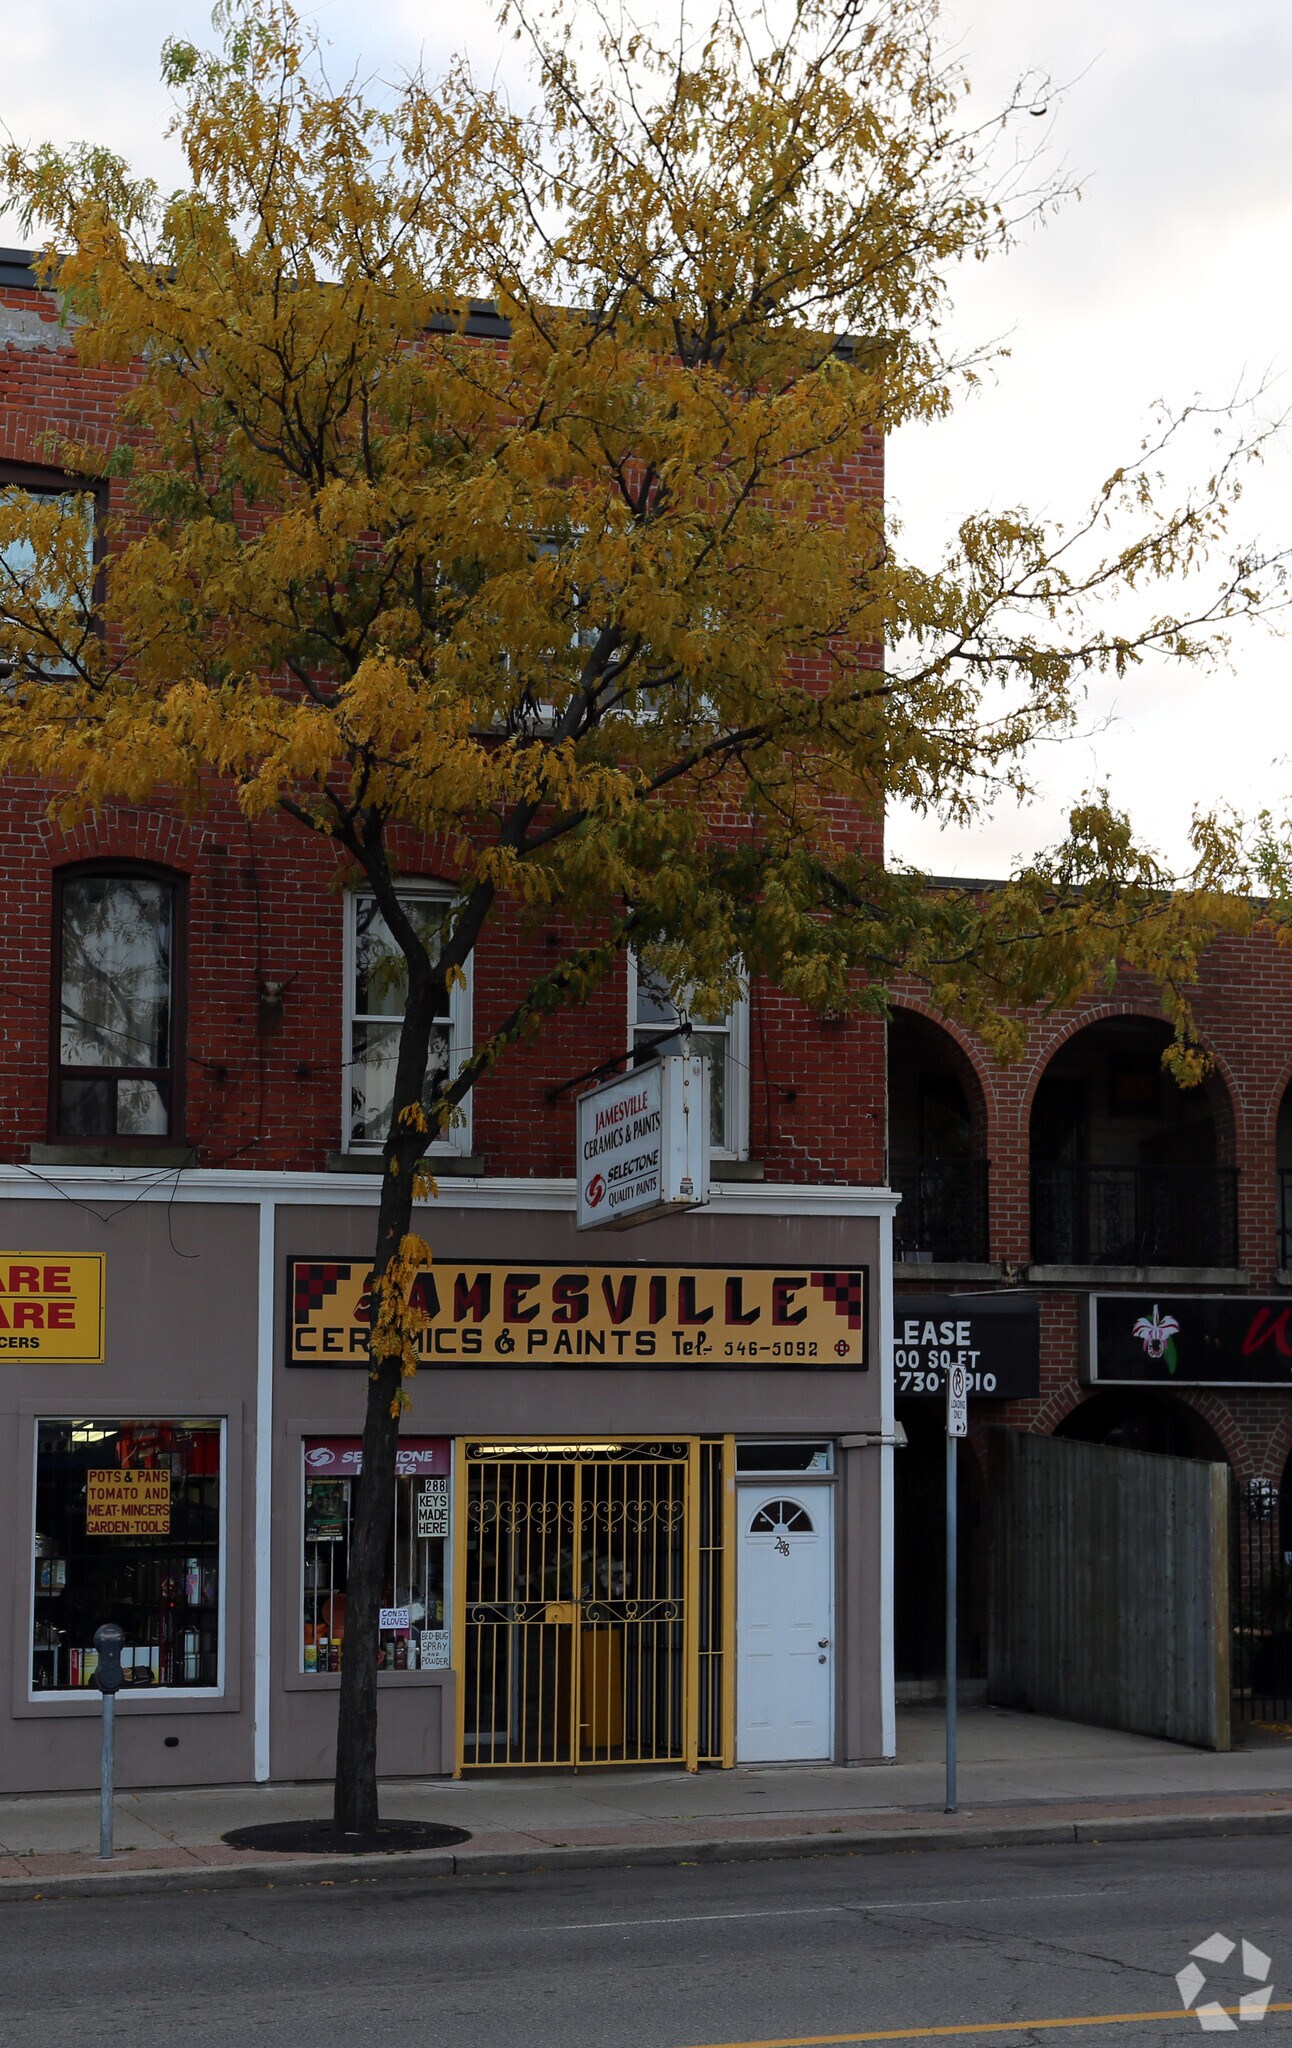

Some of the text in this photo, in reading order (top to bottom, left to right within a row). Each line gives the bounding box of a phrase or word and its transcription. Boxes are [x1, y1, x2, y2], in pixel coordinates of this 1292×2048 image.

[595, 1091, 648, 1135] JAMESVILLE
[584, 1110, 660, 1160] CERAMICS & PAINTS
[608, 1150, 659, 1183] SELECTONE
[609, 1185, 635, 1208] QUALITY
[636, 1176, 657, 1196] PAINTS
[0, 1266, 71, 1292] RE
[0, 1336, 40, 1348] CERS
[295, 1327, 482, 1356] CERMICS
[494, 1327, 516, 1355] &
[528, 1328, 656, 1356] PAINTS
[724, 1342, 818, 1357] 546-5092
[958, 1351, 980, 1368] FT
[342, 1450, 433, 1462] SETONE
[89, 1471, 168, 1482] POTS & PANS
[426, 1481, 445, 1492] 288
[89, 1488, 168, 1499] TOMATO AND
[419, 1496, 447, 1507] KEYS
[419, 1510, 447, 1520] MADE
[419, 1523, 446, 1534] HERE
[774, 1536, 790, 1556] 288
[381, 1618, 408, 1626] GLOVES
[422, 1642, 447, 1651] SPRAY
[422, 1657, 449, 1665] POWDER
